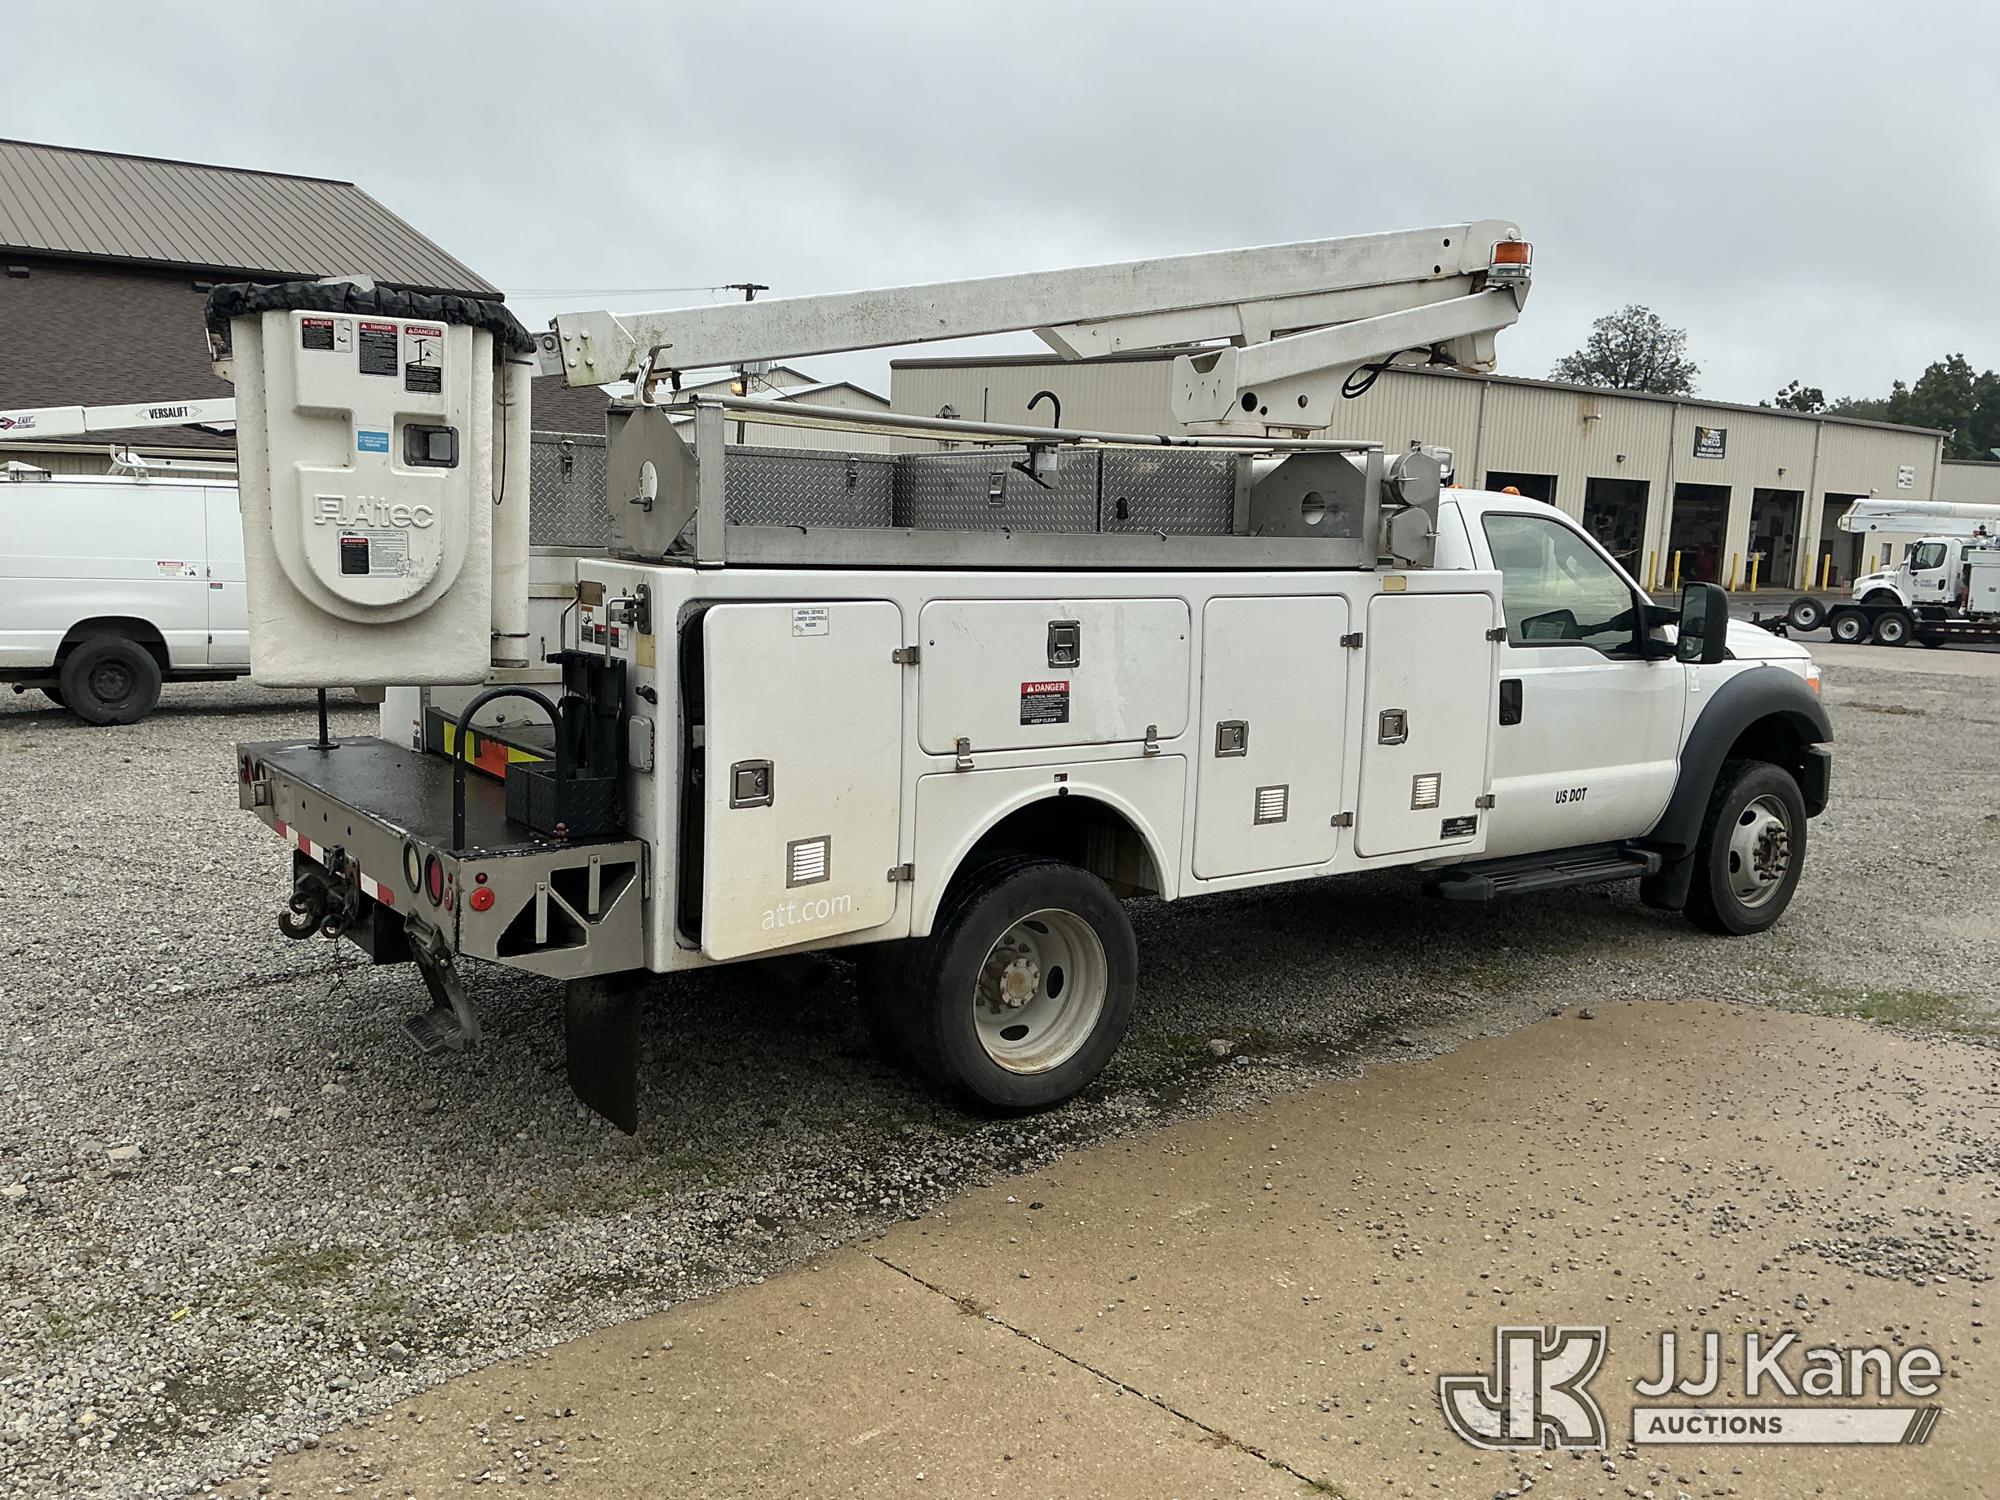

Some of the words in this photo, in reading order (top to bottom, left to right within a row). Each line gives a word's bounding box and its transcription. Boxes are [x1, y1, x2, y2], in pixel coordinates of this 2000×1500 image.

[413, 328, 440, 336] DANGER
[148, 406, 188, 419] VERSALIFT
[1034, 682, 1065, 692] DANGER
[1555, 789, 1568, 804] US
[1569, 787, 1588, 802] DOT
[761, 894, 852, 930] att.com
